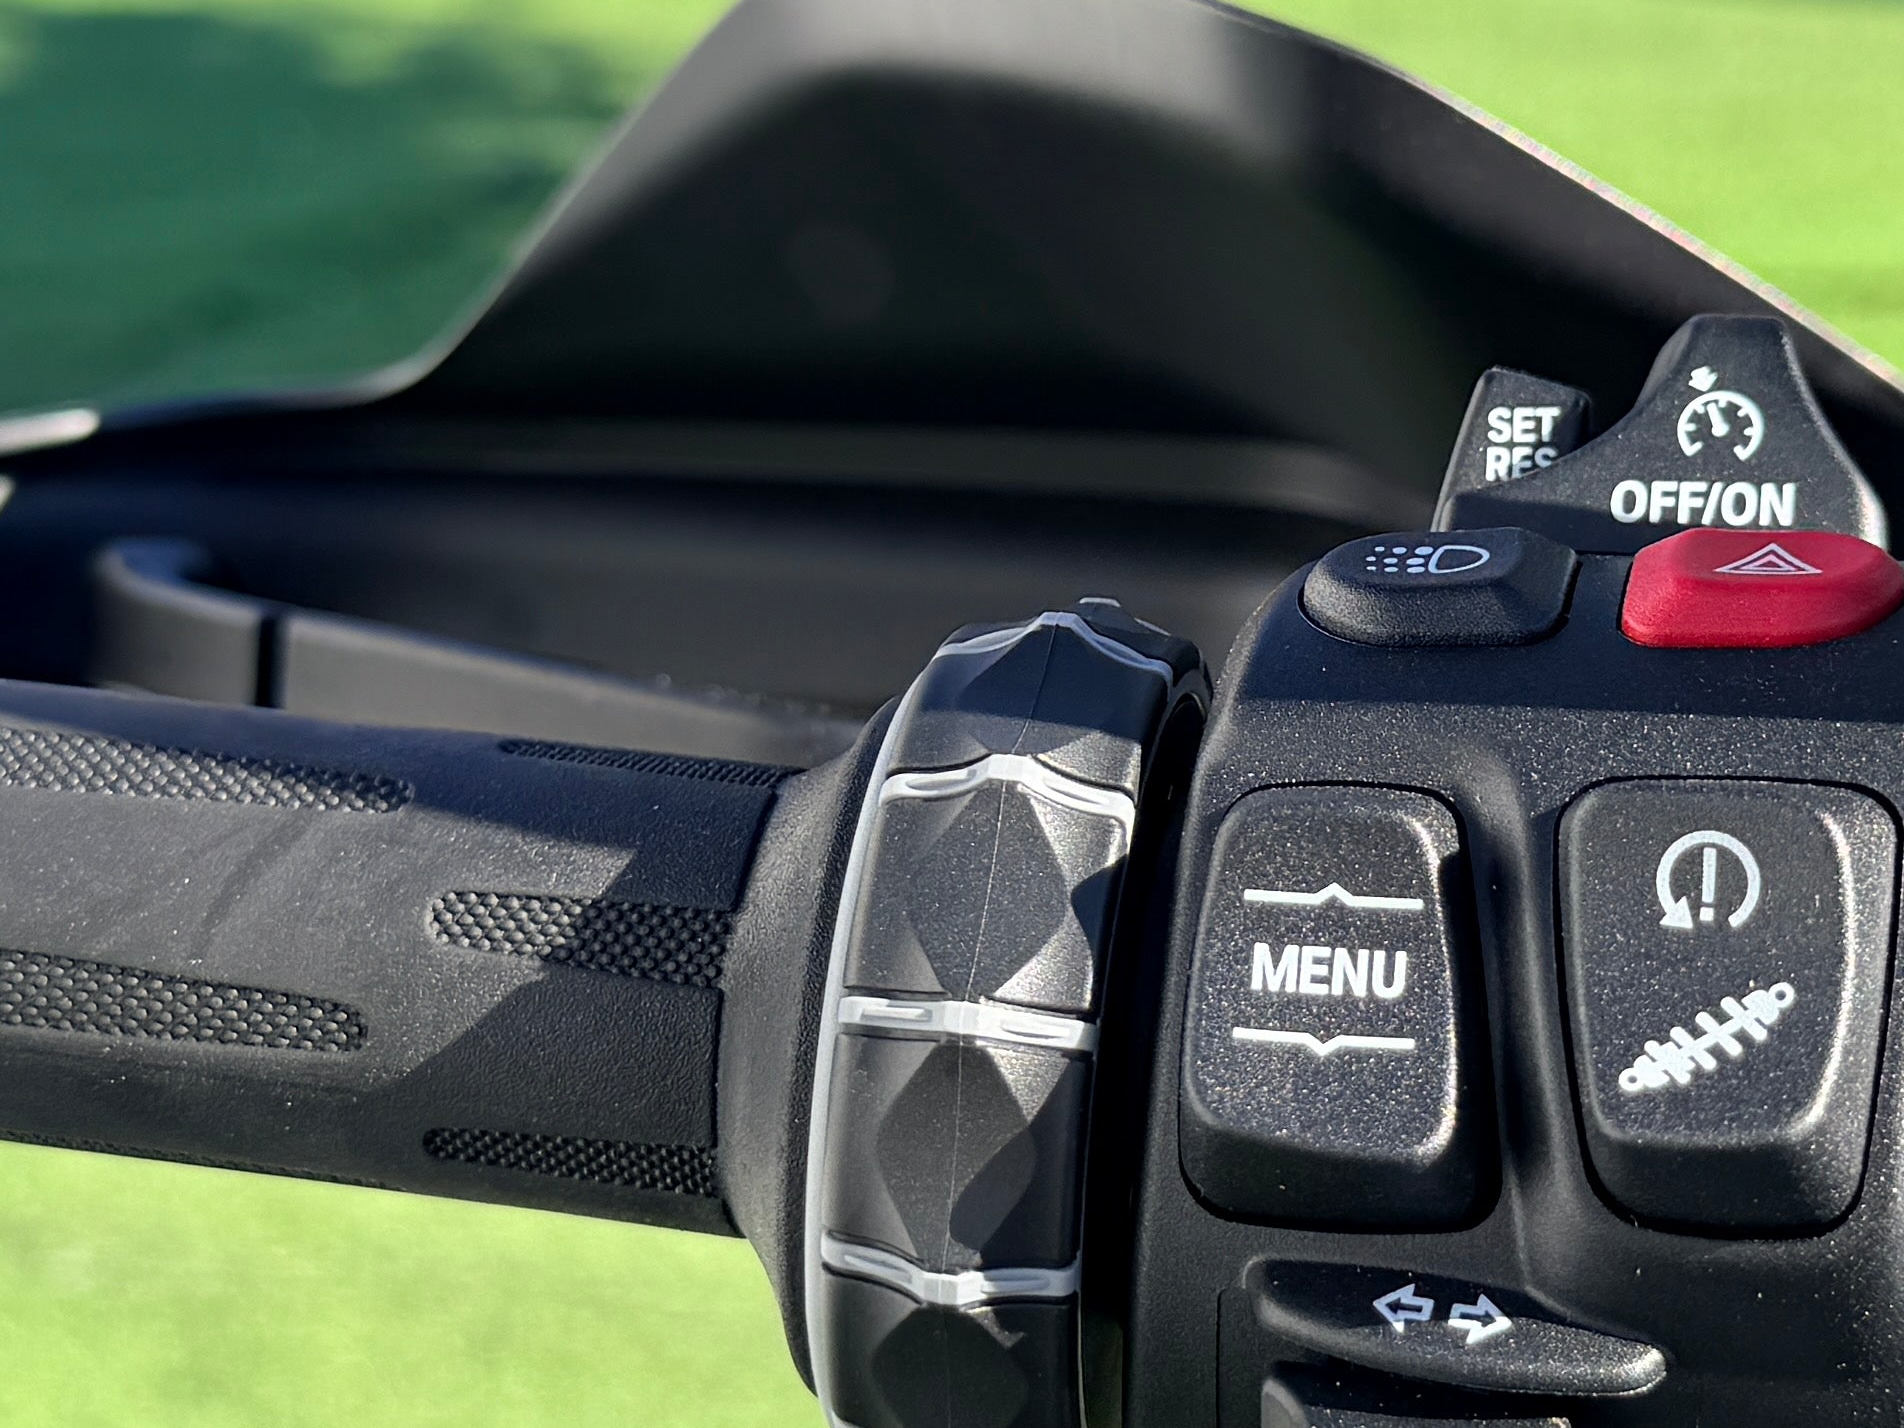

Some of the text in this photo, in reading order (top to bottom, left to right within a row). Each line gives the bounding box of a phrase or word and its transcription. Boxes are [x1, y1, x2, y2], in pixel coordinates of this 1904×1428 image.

[1487, 406, 1562, 444] SET
[1610, 479, 1797, 527] OFF/ON
[1250, 941, 1408, 1000] MENU
